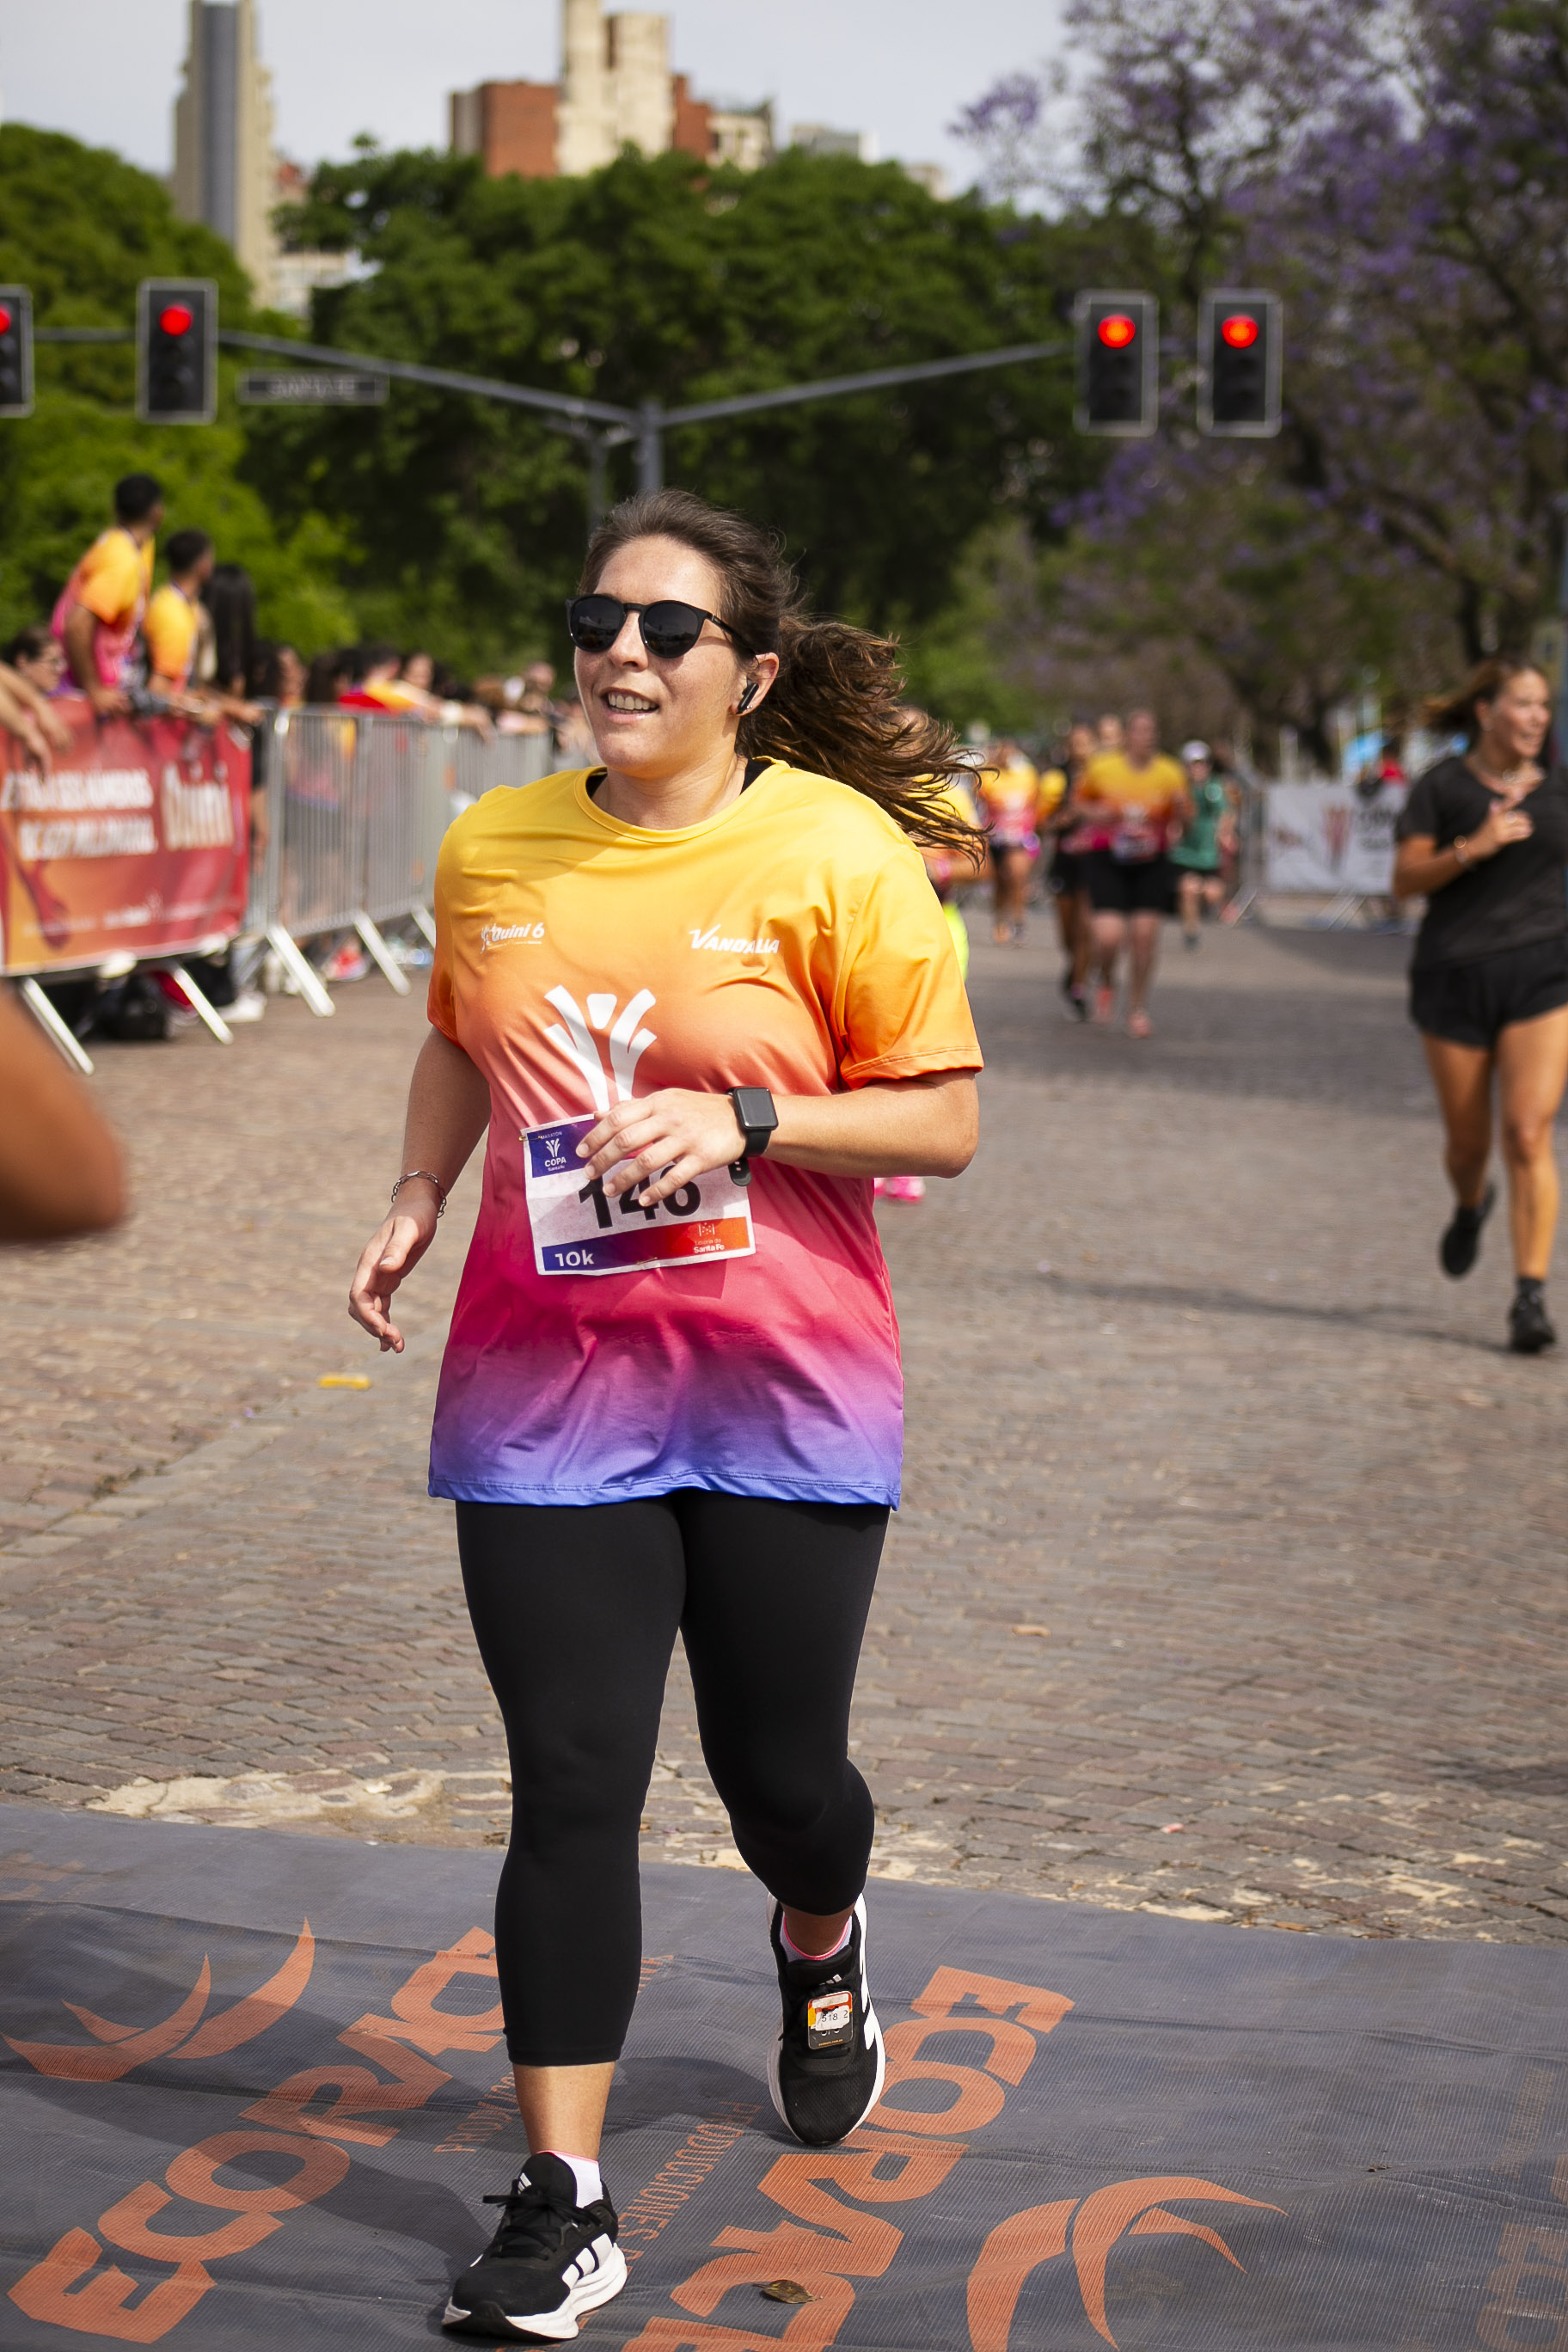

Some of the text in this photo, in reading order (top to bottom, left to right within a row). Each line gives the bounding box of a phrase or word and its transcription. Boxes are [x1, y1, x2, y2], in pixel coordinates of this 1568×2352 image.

[491, 922, 545, 942] Quini 6
[689, 923, 780, 954] VANDALIA
[544, 1156, 567, 1167] COPA
[693, 1243, 726, 1253] Santa Fe
[554, 1249, 595, 1267] 10k
[618, 2101, 762, 2241] PRODUCCIONES
